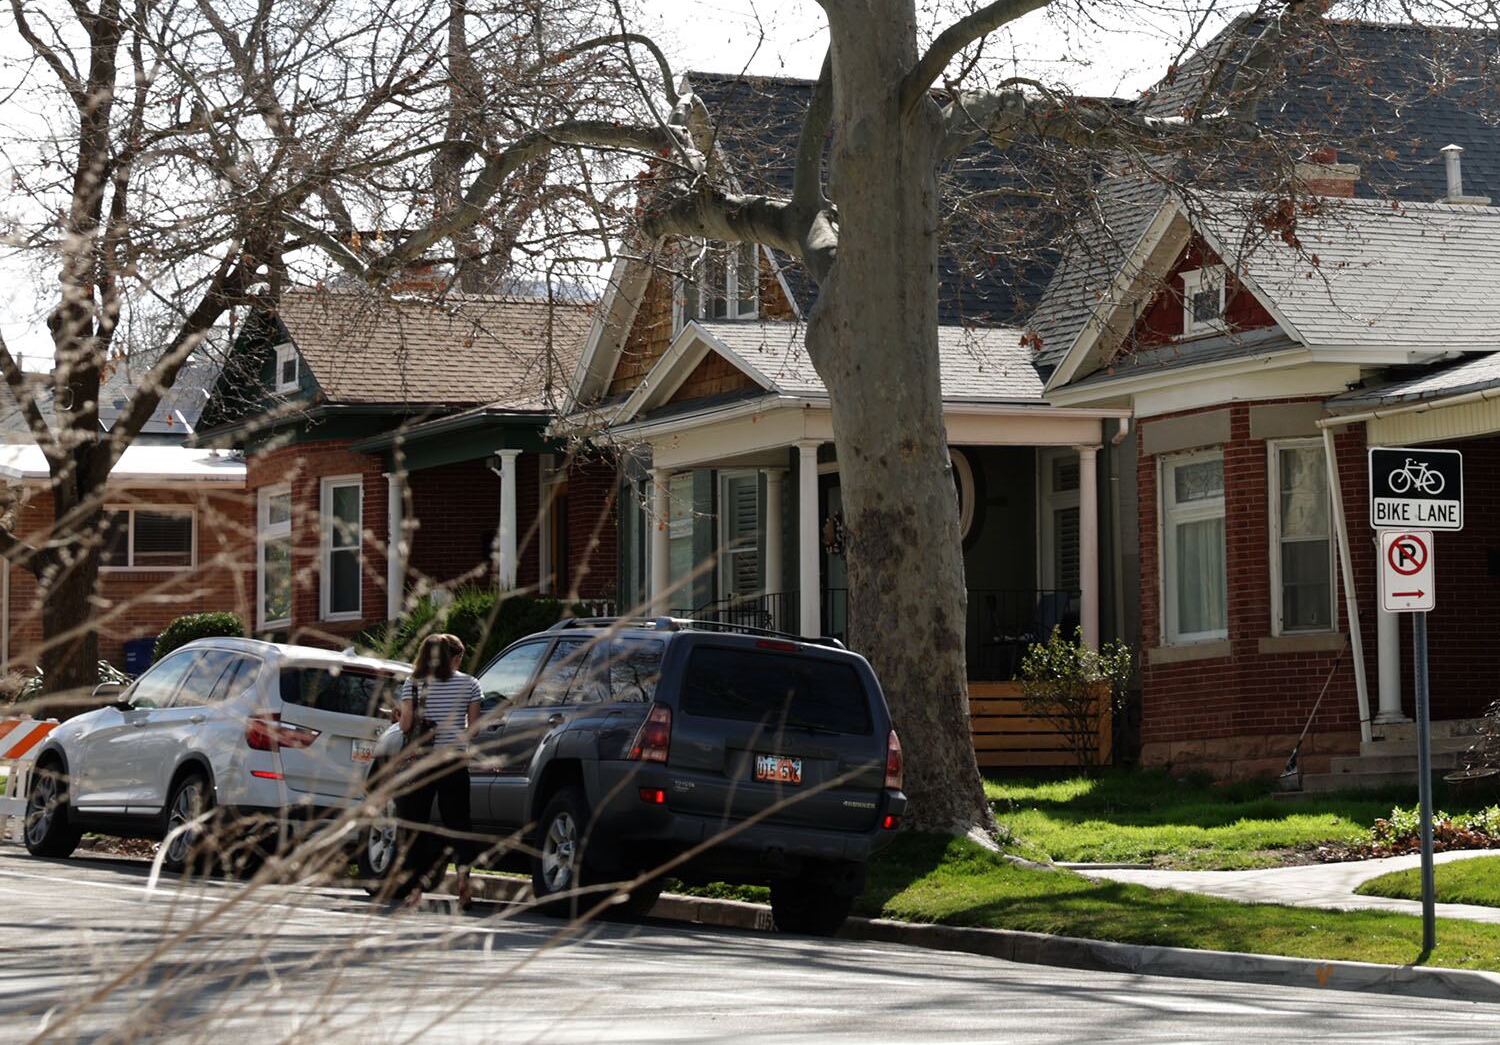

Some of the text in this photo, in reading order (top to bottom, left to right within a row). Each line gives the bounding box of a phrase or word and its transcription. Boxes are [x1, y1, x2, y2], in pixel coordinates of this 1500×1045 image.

[1377, 503, 1457, 522] BIKE LANE
[1399, 543, 1417, 567] P
